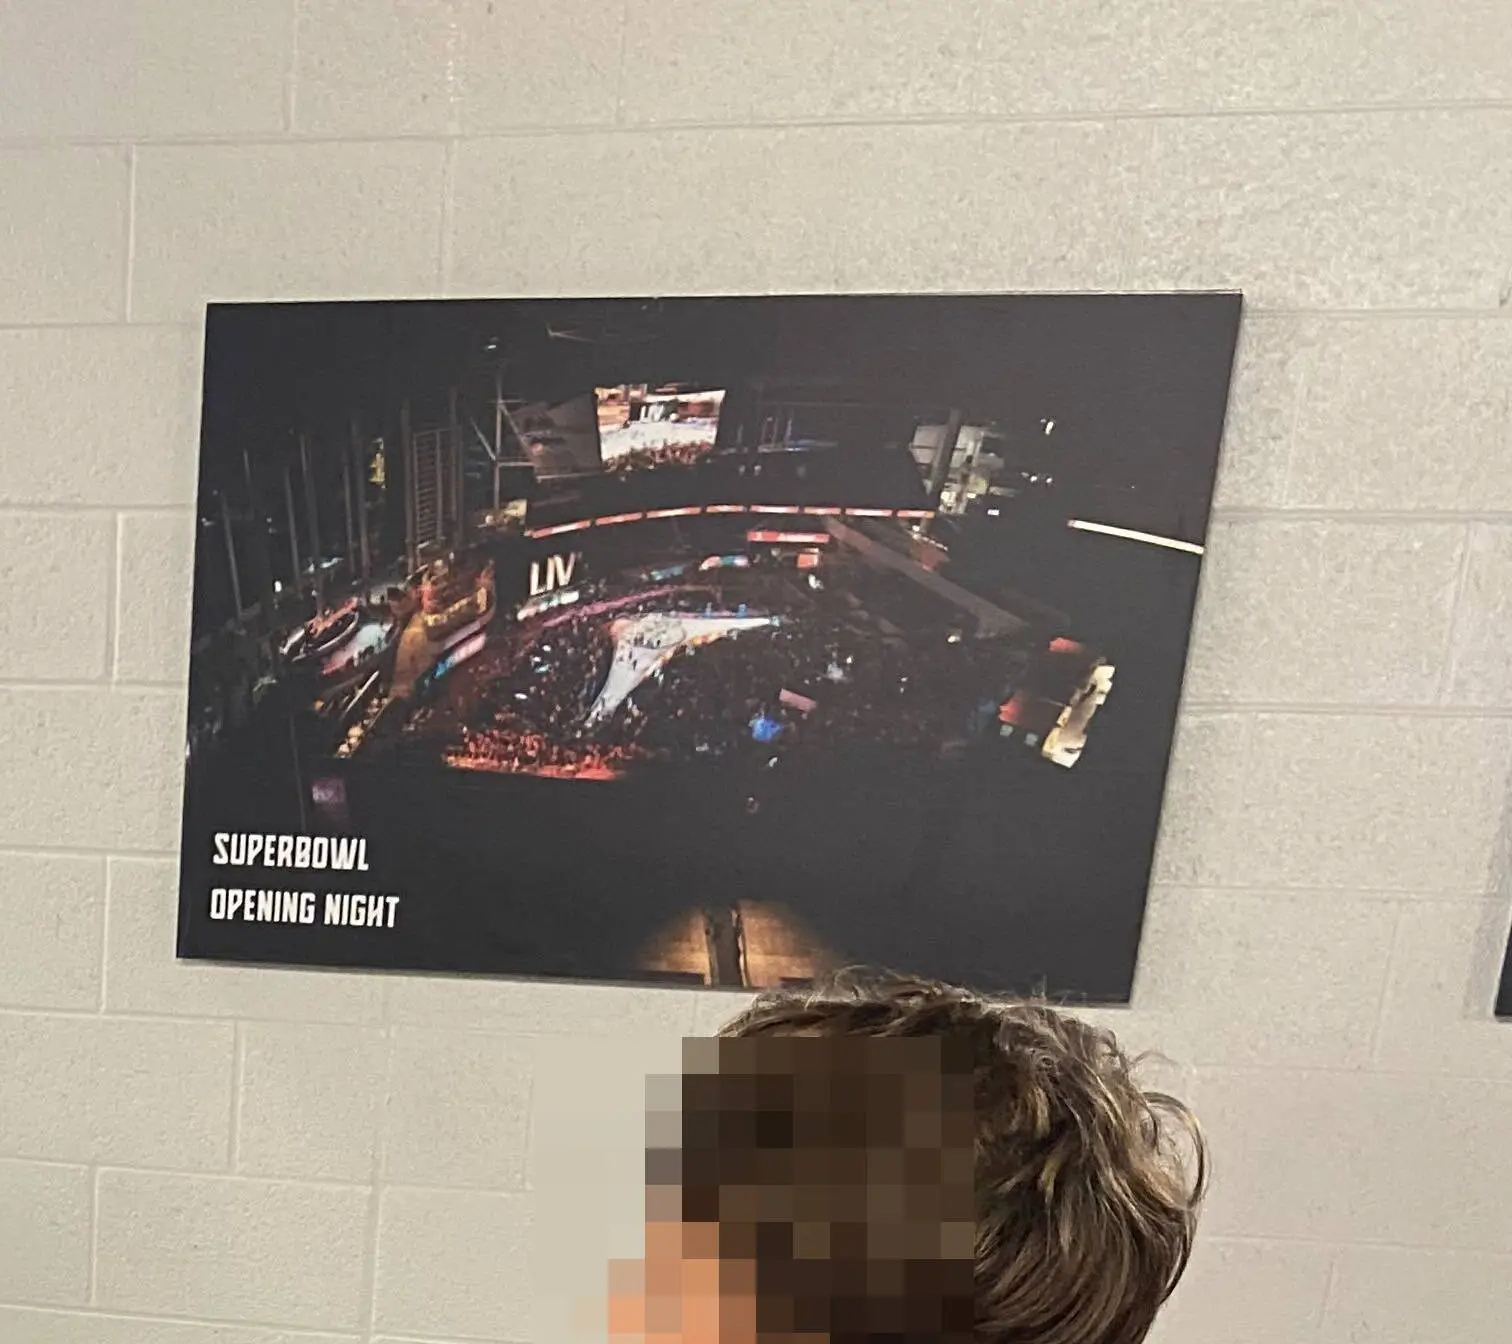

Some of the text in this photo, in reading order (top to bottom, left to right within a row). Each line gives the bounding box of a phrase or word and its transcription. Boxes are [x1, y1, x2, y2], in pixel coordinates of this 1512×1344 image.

[530, 552, 577, 595] LIV
[213, 832, 369, 871] SUPERBOWL
[210, 888, 400, 928] OPENING NIGHT
